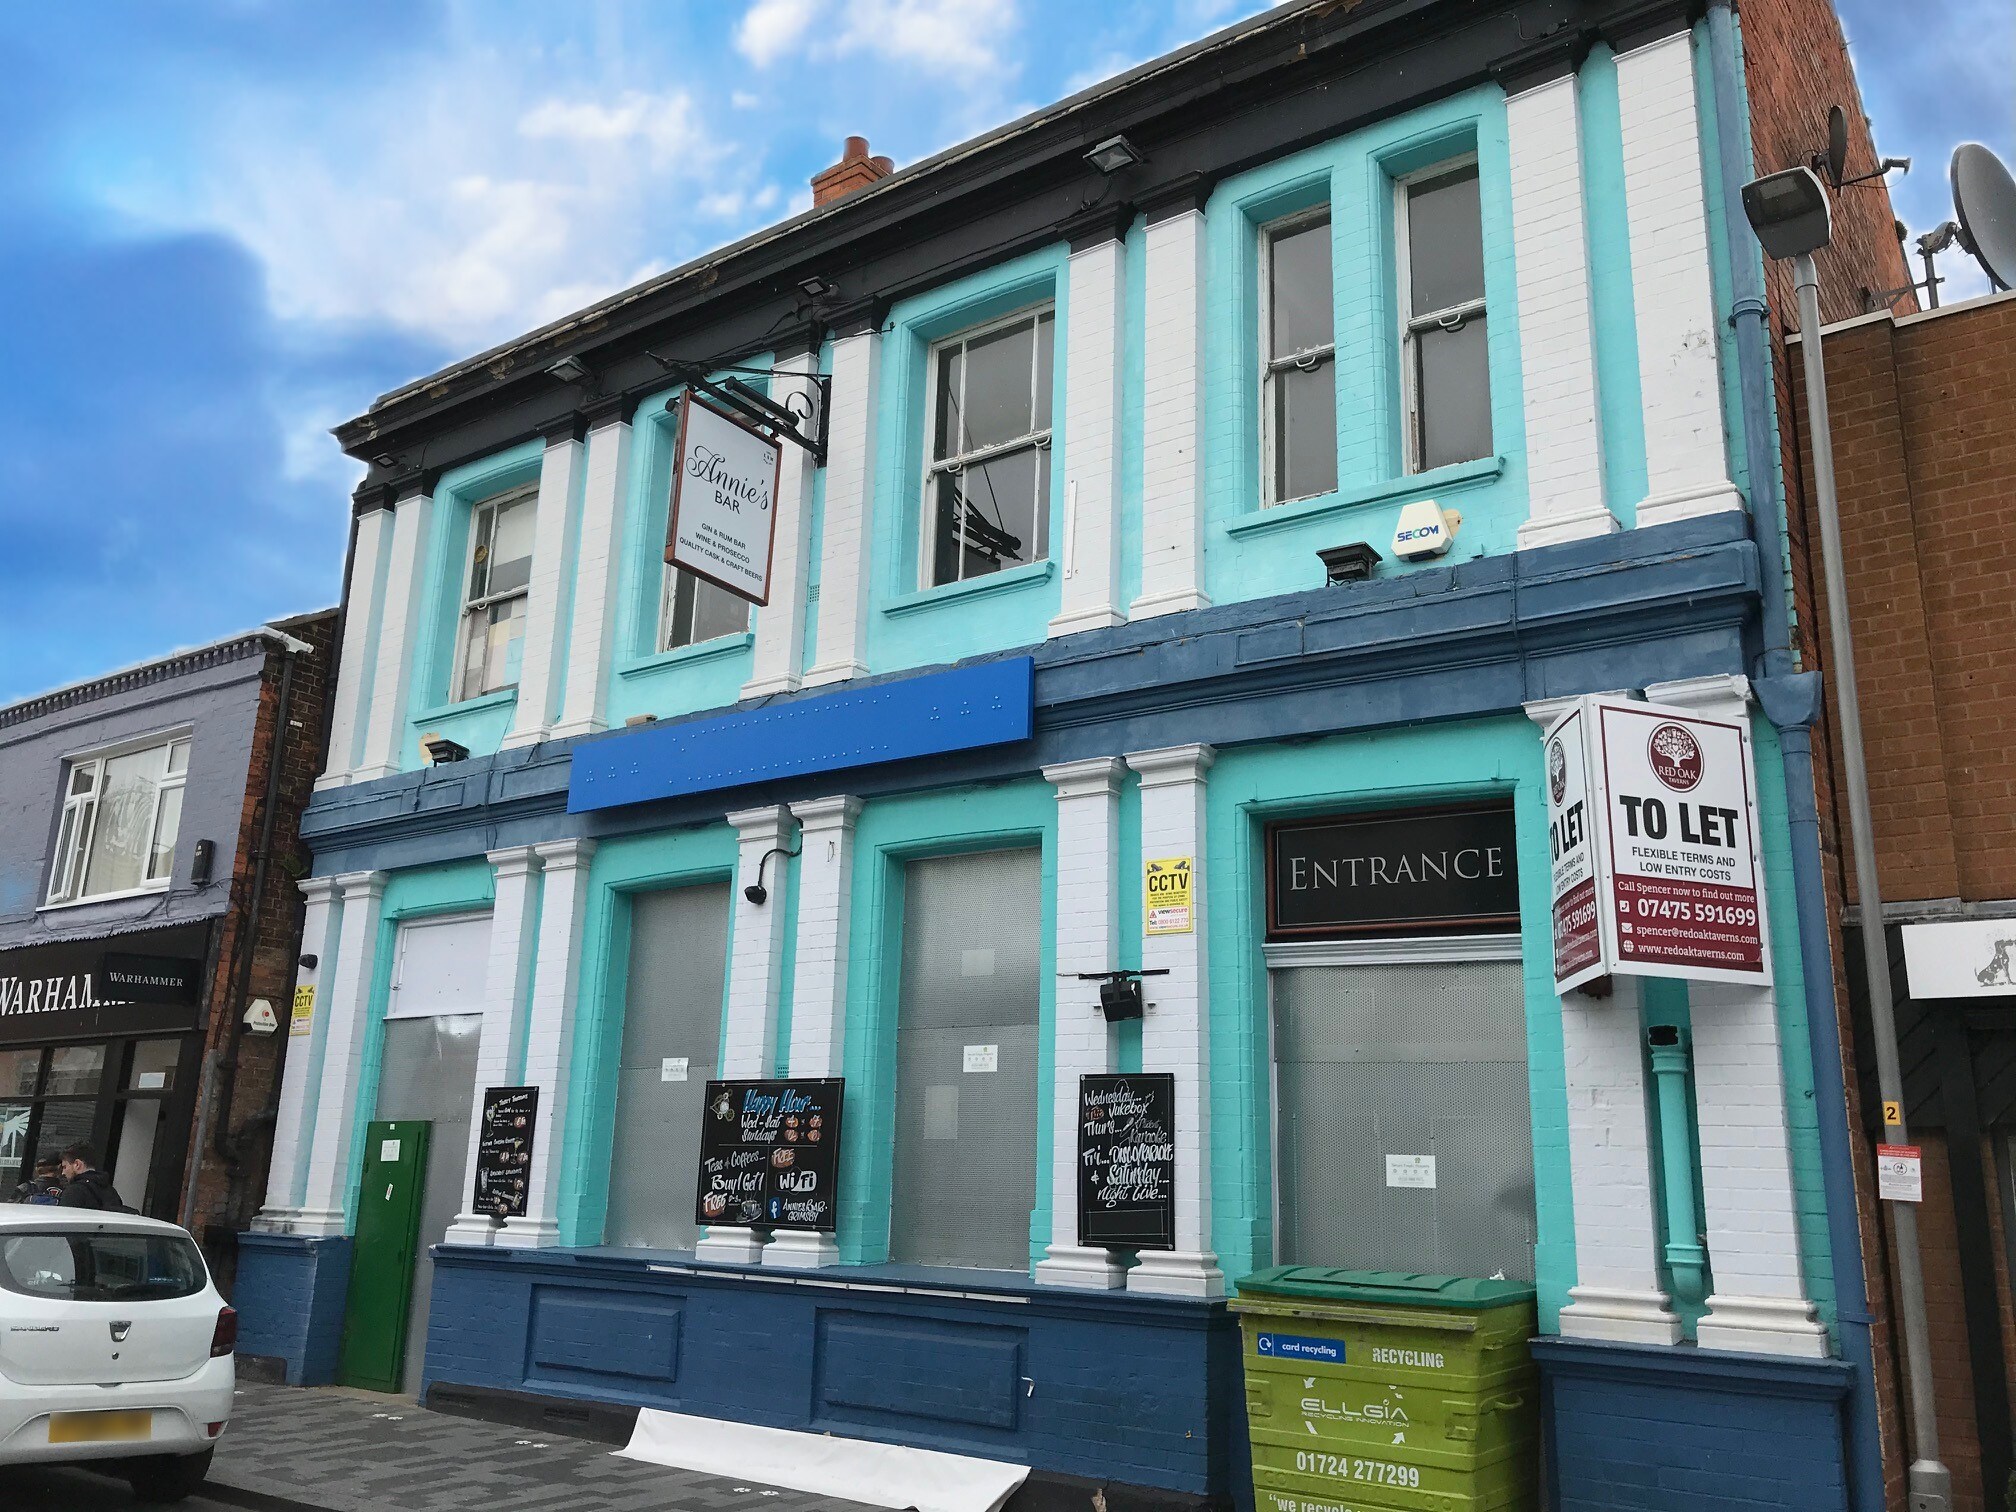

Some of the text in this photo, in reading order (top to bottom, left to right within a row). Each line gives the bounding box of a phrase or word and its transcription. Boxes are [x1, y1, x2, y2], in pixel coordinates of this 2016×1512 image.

[686, 446, 768, 510] Annie's
[715, 490, 741, 515] BAR
[701, 523, 713, 534] GIN
[719, 531, 733, 543] RUM
[734, 539, 746, 550] BAR
[1397, 525, 1439, 542] SECOM
[696, 532, 711, 545] WINE
[718, 543, 750, 564] PROSECCO
[680, 537, 704, 553] QUALITY
[705, 549, 720, 561] CASK
[726, 560, 744, 572] CRAFT
[745, 569, 763, 582] BEERS
[1658, 766, 1697, 780] RED OAK
[1668, 777, 1690, 786] TAVERNS
[1561, 800, 1583, 854] LET
[1619, 795, 1739, 849] TO LET
[1632, 847, 1736, 867] FLEXIBLE TERMS AND
[1290, 847, 1504, 891] ENTRANCE
[1640, 862, 1731, 881] LOW ENTRY COSTS
[1149, 873, 1188, 892] CCTV
[1618, 881, 1755, 903] Call Spencer now to find out more
[1572, 900, 1596, 930] 591699
[1638, 898, 1756, 927] 07475 591699
[1636, 926, 1758, 945] spencer@redoaktaverns.com
[1638, 944, 1745, 961] www.redoaktaverns.com
[109, 972, 183, 987] WARHAMMER
[294, 994, 313, 1007] CCTV
[742, 1088, 779, 1116] Happy
[1108, 1102, 1149, 1118] Jukebox
[1886, 1106, 1897, 1120] 2
[1131, 1126, 1167, 1144] Karaoke
[705, 1157, 723, 1173] Teas
[711, 1175, 737, 1194] Buy
[704, 1191, 728, 1212] FREE
[788, 1211, 818, 1222] GRIMSBY
[1282, 1343, 1337, 1358] card recycling
[1372, 1347, 1444, 1369] RECYCLING
[1301, 1411, 1410, 1428] RECYCLING INNOVATION
[1297, 1451, 1419, 1488] 01724 277299
